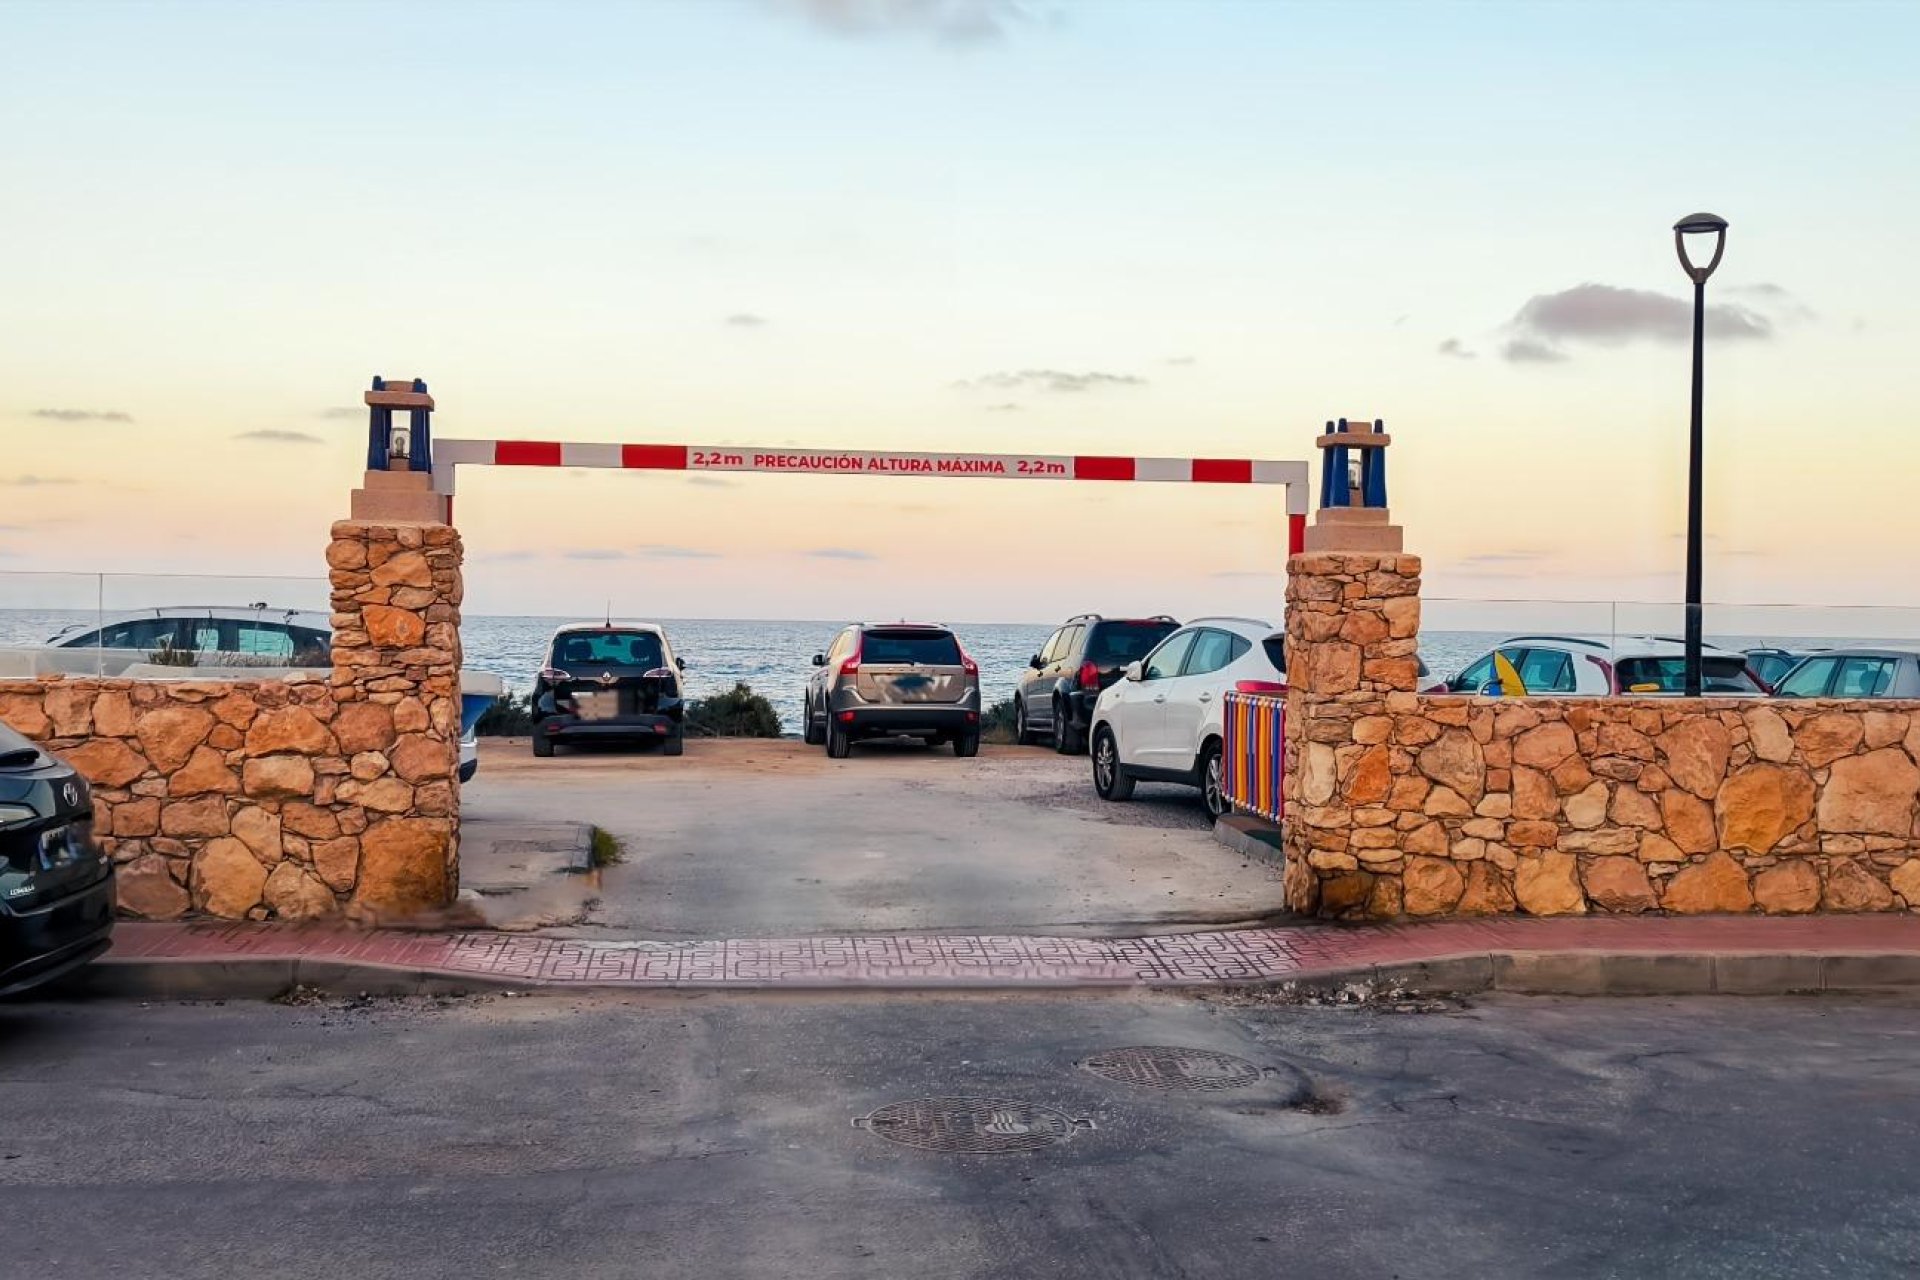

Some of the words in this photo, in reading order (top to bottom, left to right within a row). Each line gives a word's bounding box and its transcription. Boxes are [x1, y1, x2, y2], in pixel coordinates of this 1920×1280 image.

[754, 454, 864, 470] PRECAUCIÓN
[868, 458, 933, 471] ALTURA
[937, 457, 1005, 473] MÁXIMA
